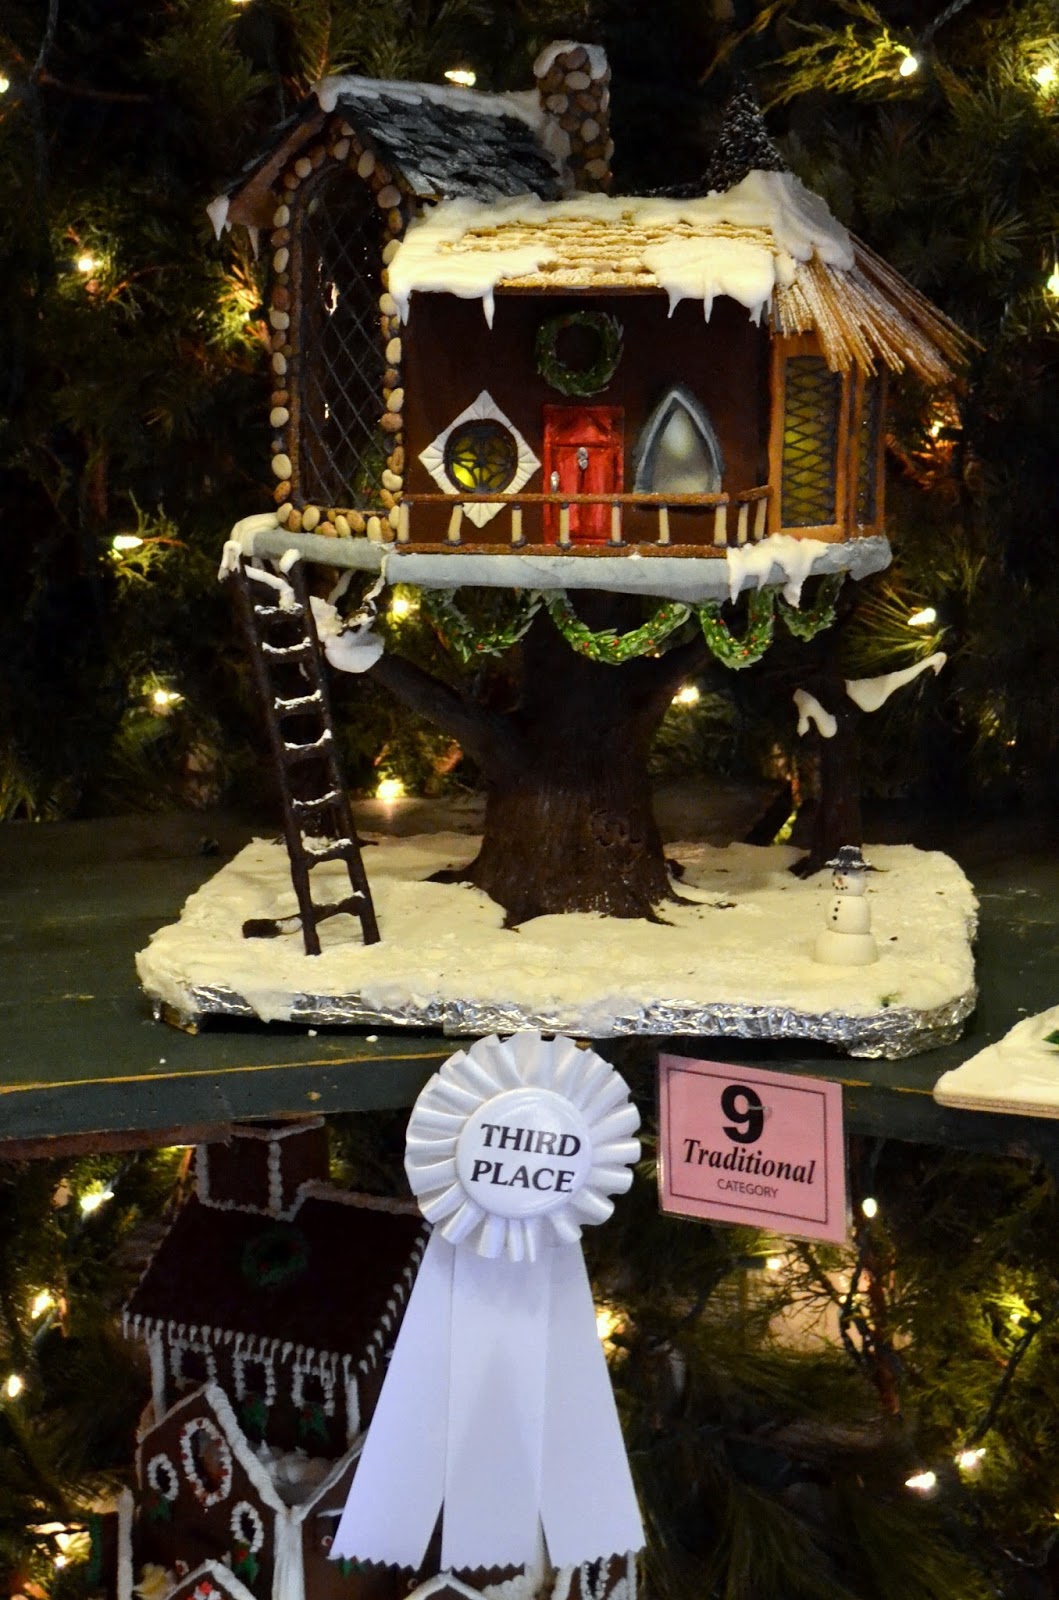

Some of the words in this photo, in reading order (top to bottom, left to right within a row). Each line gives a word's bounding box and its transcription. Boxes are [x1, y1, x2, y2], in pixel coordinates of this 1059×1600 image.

[720, 1084, 764, 1144] 9
[480, 1123, 581, 1157] THIRD
[470, 1159, 575, 1193] PLACE
[683, 1138, 816, 1184] Traditional
[717, 1178, 779, 1198] CATEGORY
